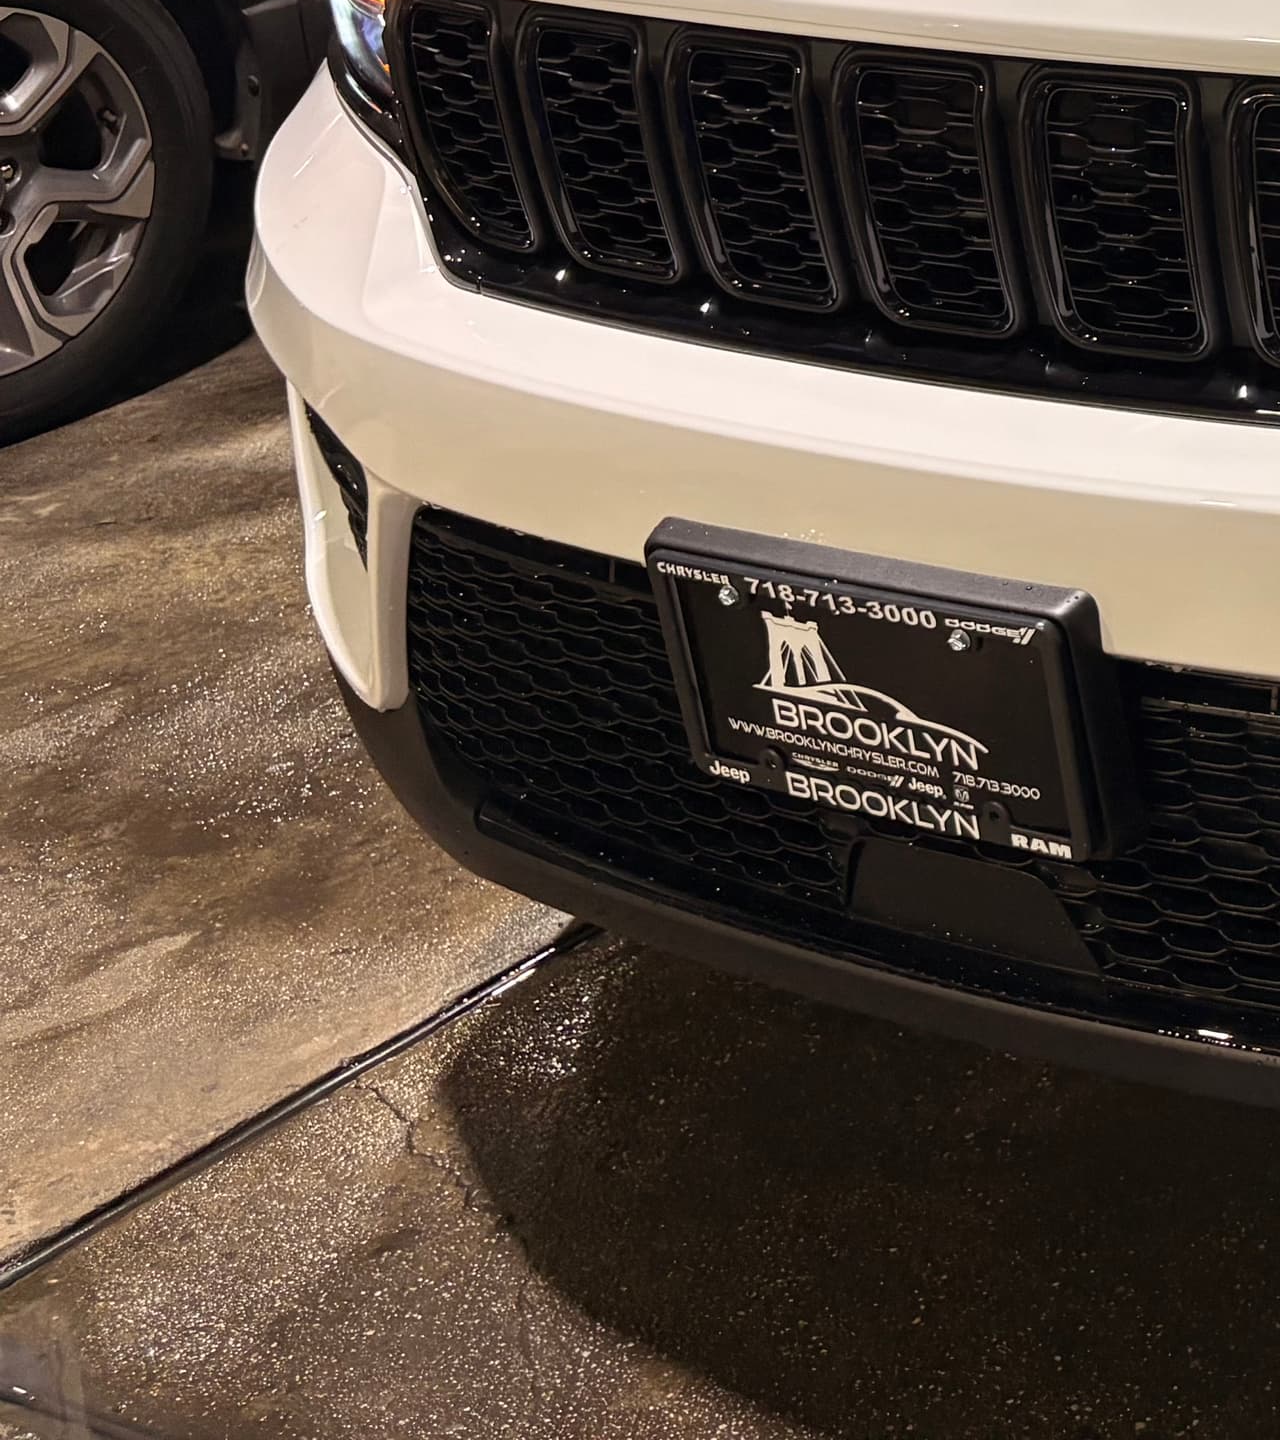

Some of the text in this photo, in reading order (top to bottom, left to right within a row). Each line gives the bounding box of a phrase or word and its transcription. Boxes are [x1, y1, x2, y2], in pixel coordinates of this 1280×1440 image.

[656, 561, 1024, 639] CHRYSLER 718-713-3000 DODGE
[728, 716, 1041, 801] WWW.BROOKLYNCHRYSLER.COM 718.713.3000
[771, 698, 979, 771] BROOKLYN
[708, 759, 751, 785] Jeep
[785, 770, 981, 841] BROOKLYN
[1010, 833, 1073, 860] RAM
[908, 776, 944, 799] Jeep
